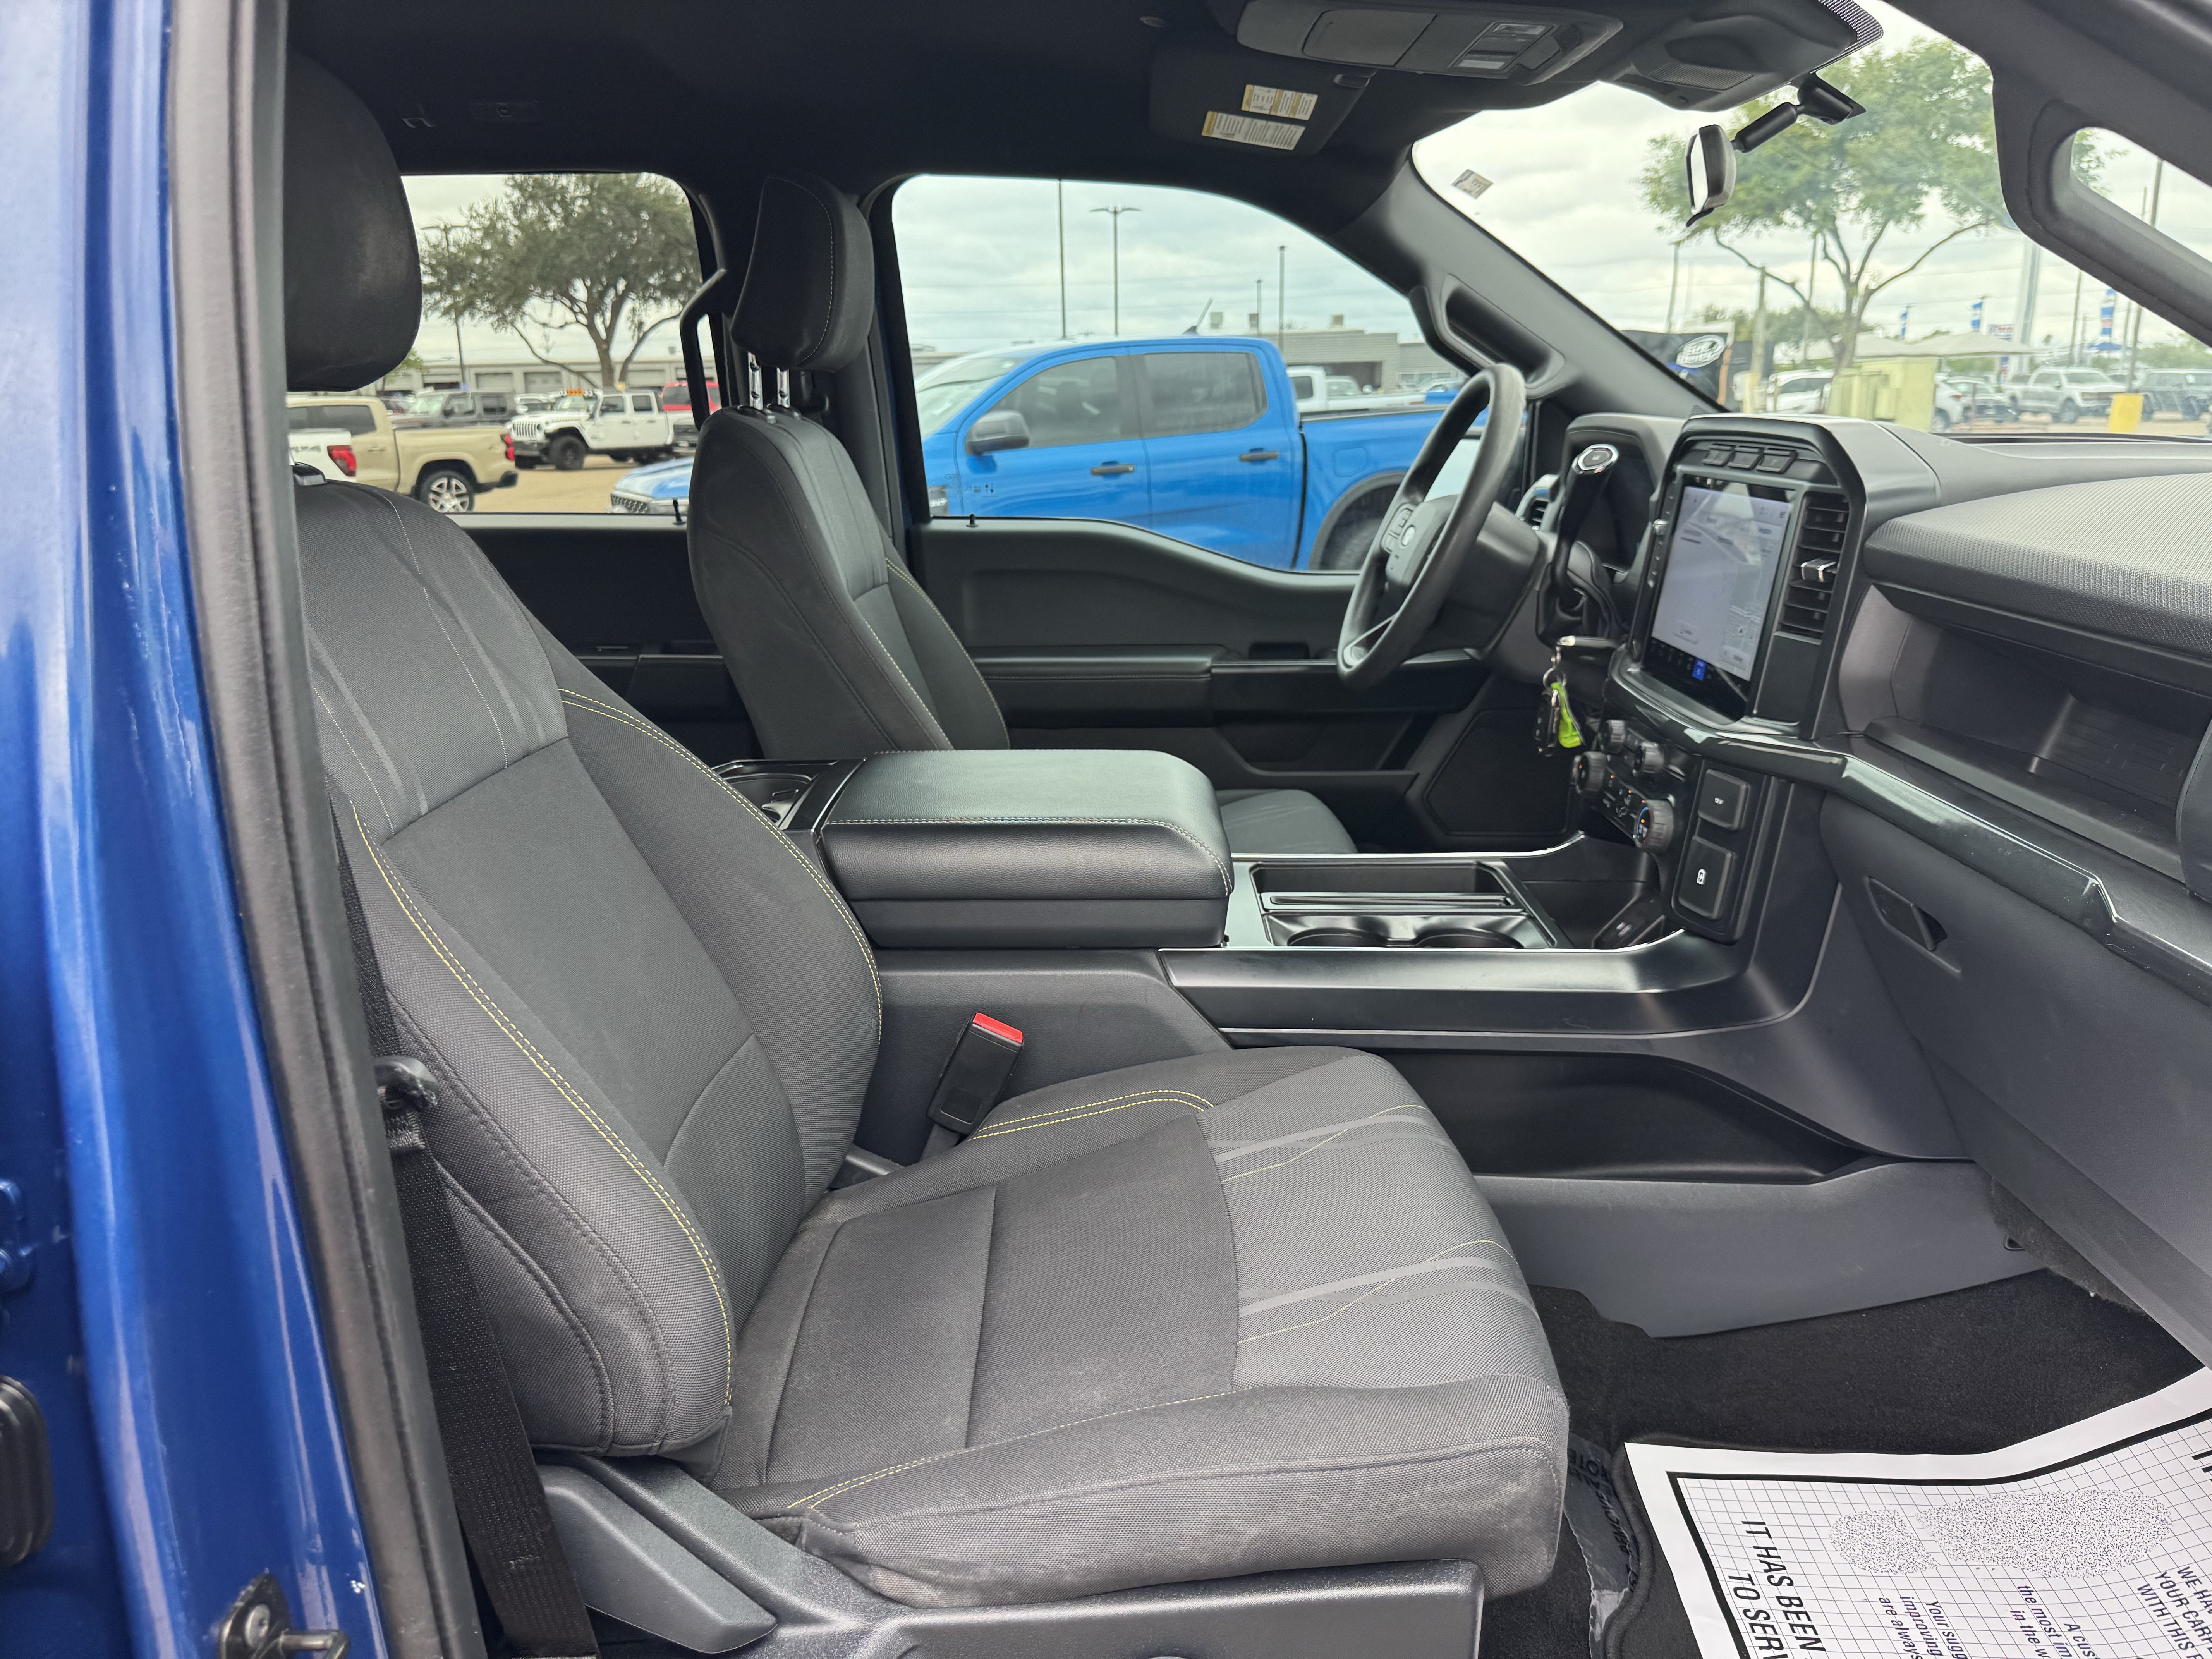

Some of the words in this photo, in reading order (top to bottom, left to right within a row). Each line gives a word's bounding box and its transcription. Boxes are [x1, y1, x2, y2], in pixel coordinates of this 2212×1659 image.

[1741, 1521, 1772, 1539] IT
[1728, 1574, 1760, 1600] TO
[1753, 1546, 1794, 1586] HAS
[2177, 1566, 2202, 1587] WE
[2193, 1589, 2212, 1614] HA
[1775, 1595, 1826, 1652] BEEN
[1879, 1598, 1897, 1615] are
[1891, 1620, 1923, 1659] always
[1900, 1596, 1943, 1656] improving
[1925, 1601, 1949, 1627] Your
[2010, 1611, 2025, 1620] in
[2020, 1625, 2040, 1644] the
[2017, 1586, 2037, 1603] the
[2031, 1609, 2062, 1637] most
[2137, 1583, 2171, 1617] WITH
[2163, 1619, 2195, 1650] THIS
[2155, 1571, 2189, 1607] YOUR
[2182, 1611, 2212, 1654] CARP
[2064, 1623, 2081, 1632] A
[2073, 1636, 2100, 1659] cus
